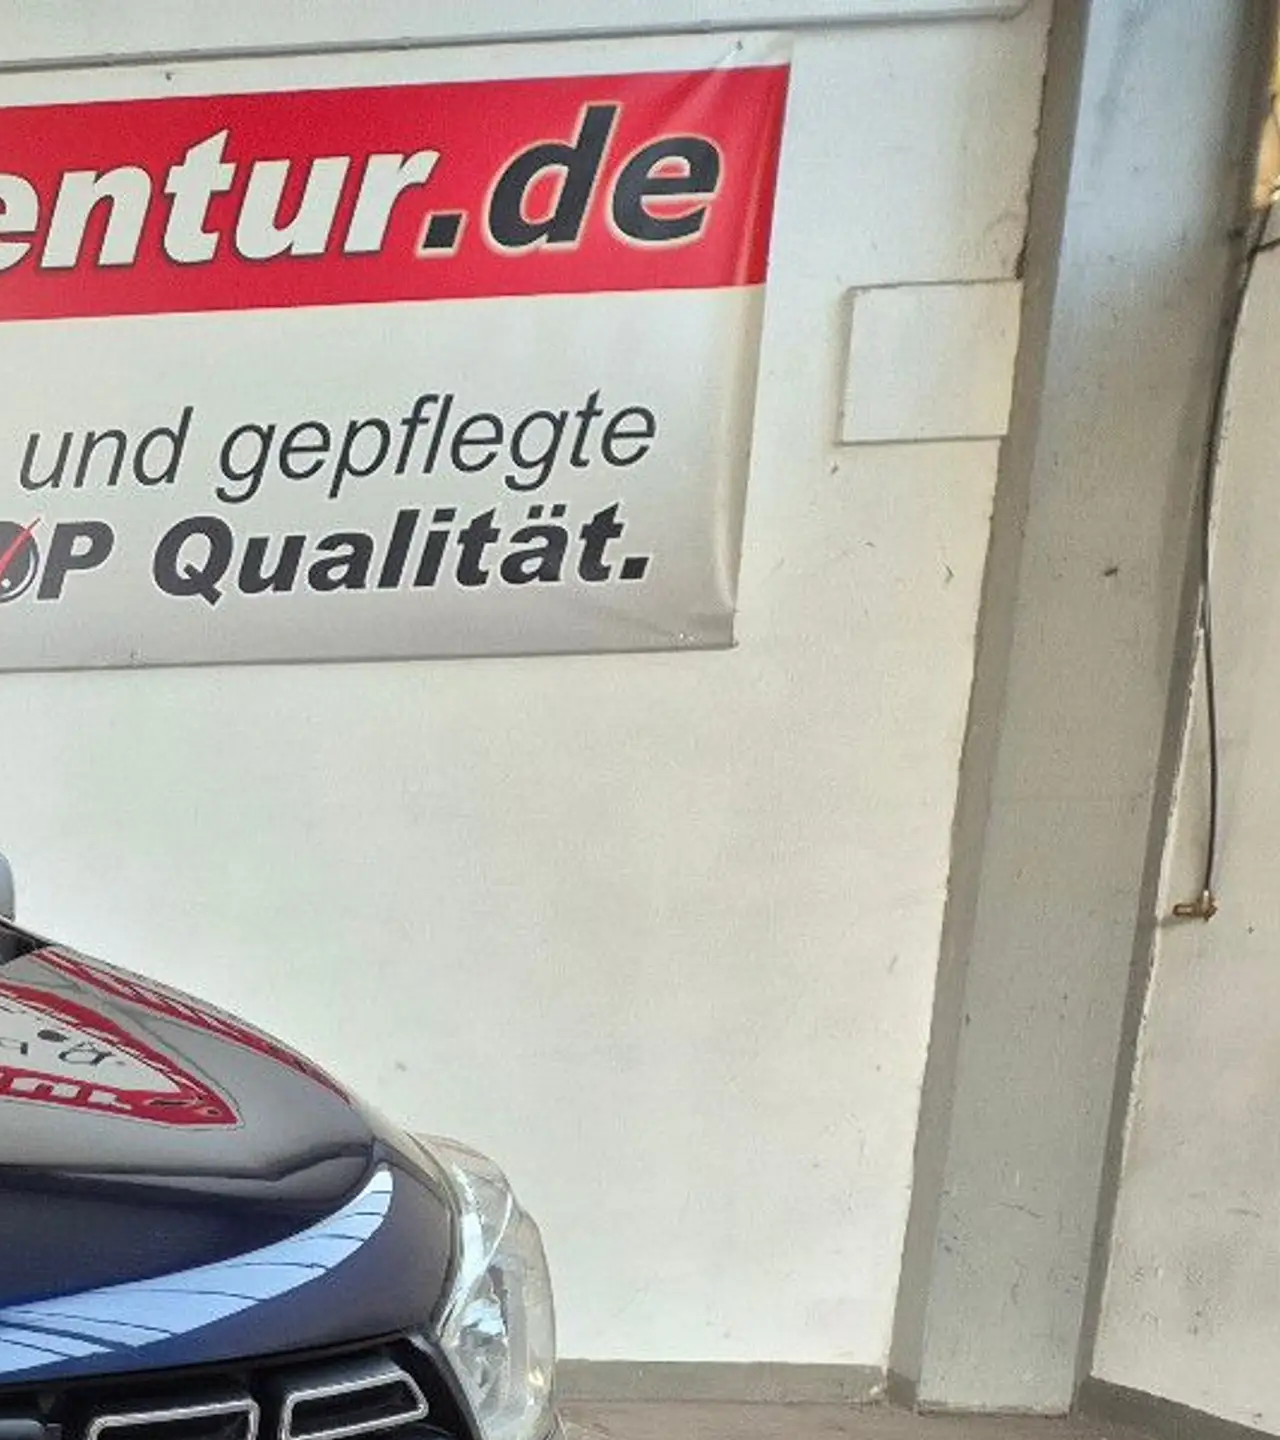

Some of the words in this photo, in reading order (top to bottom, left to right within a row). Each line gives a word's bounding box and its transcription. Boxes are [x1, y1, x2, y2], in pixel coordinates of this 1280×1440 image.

[18, 406, 195, 490] und
[215, 389, 657, 504] gepflegte
[150, 502, 650, 606] Qualität.
